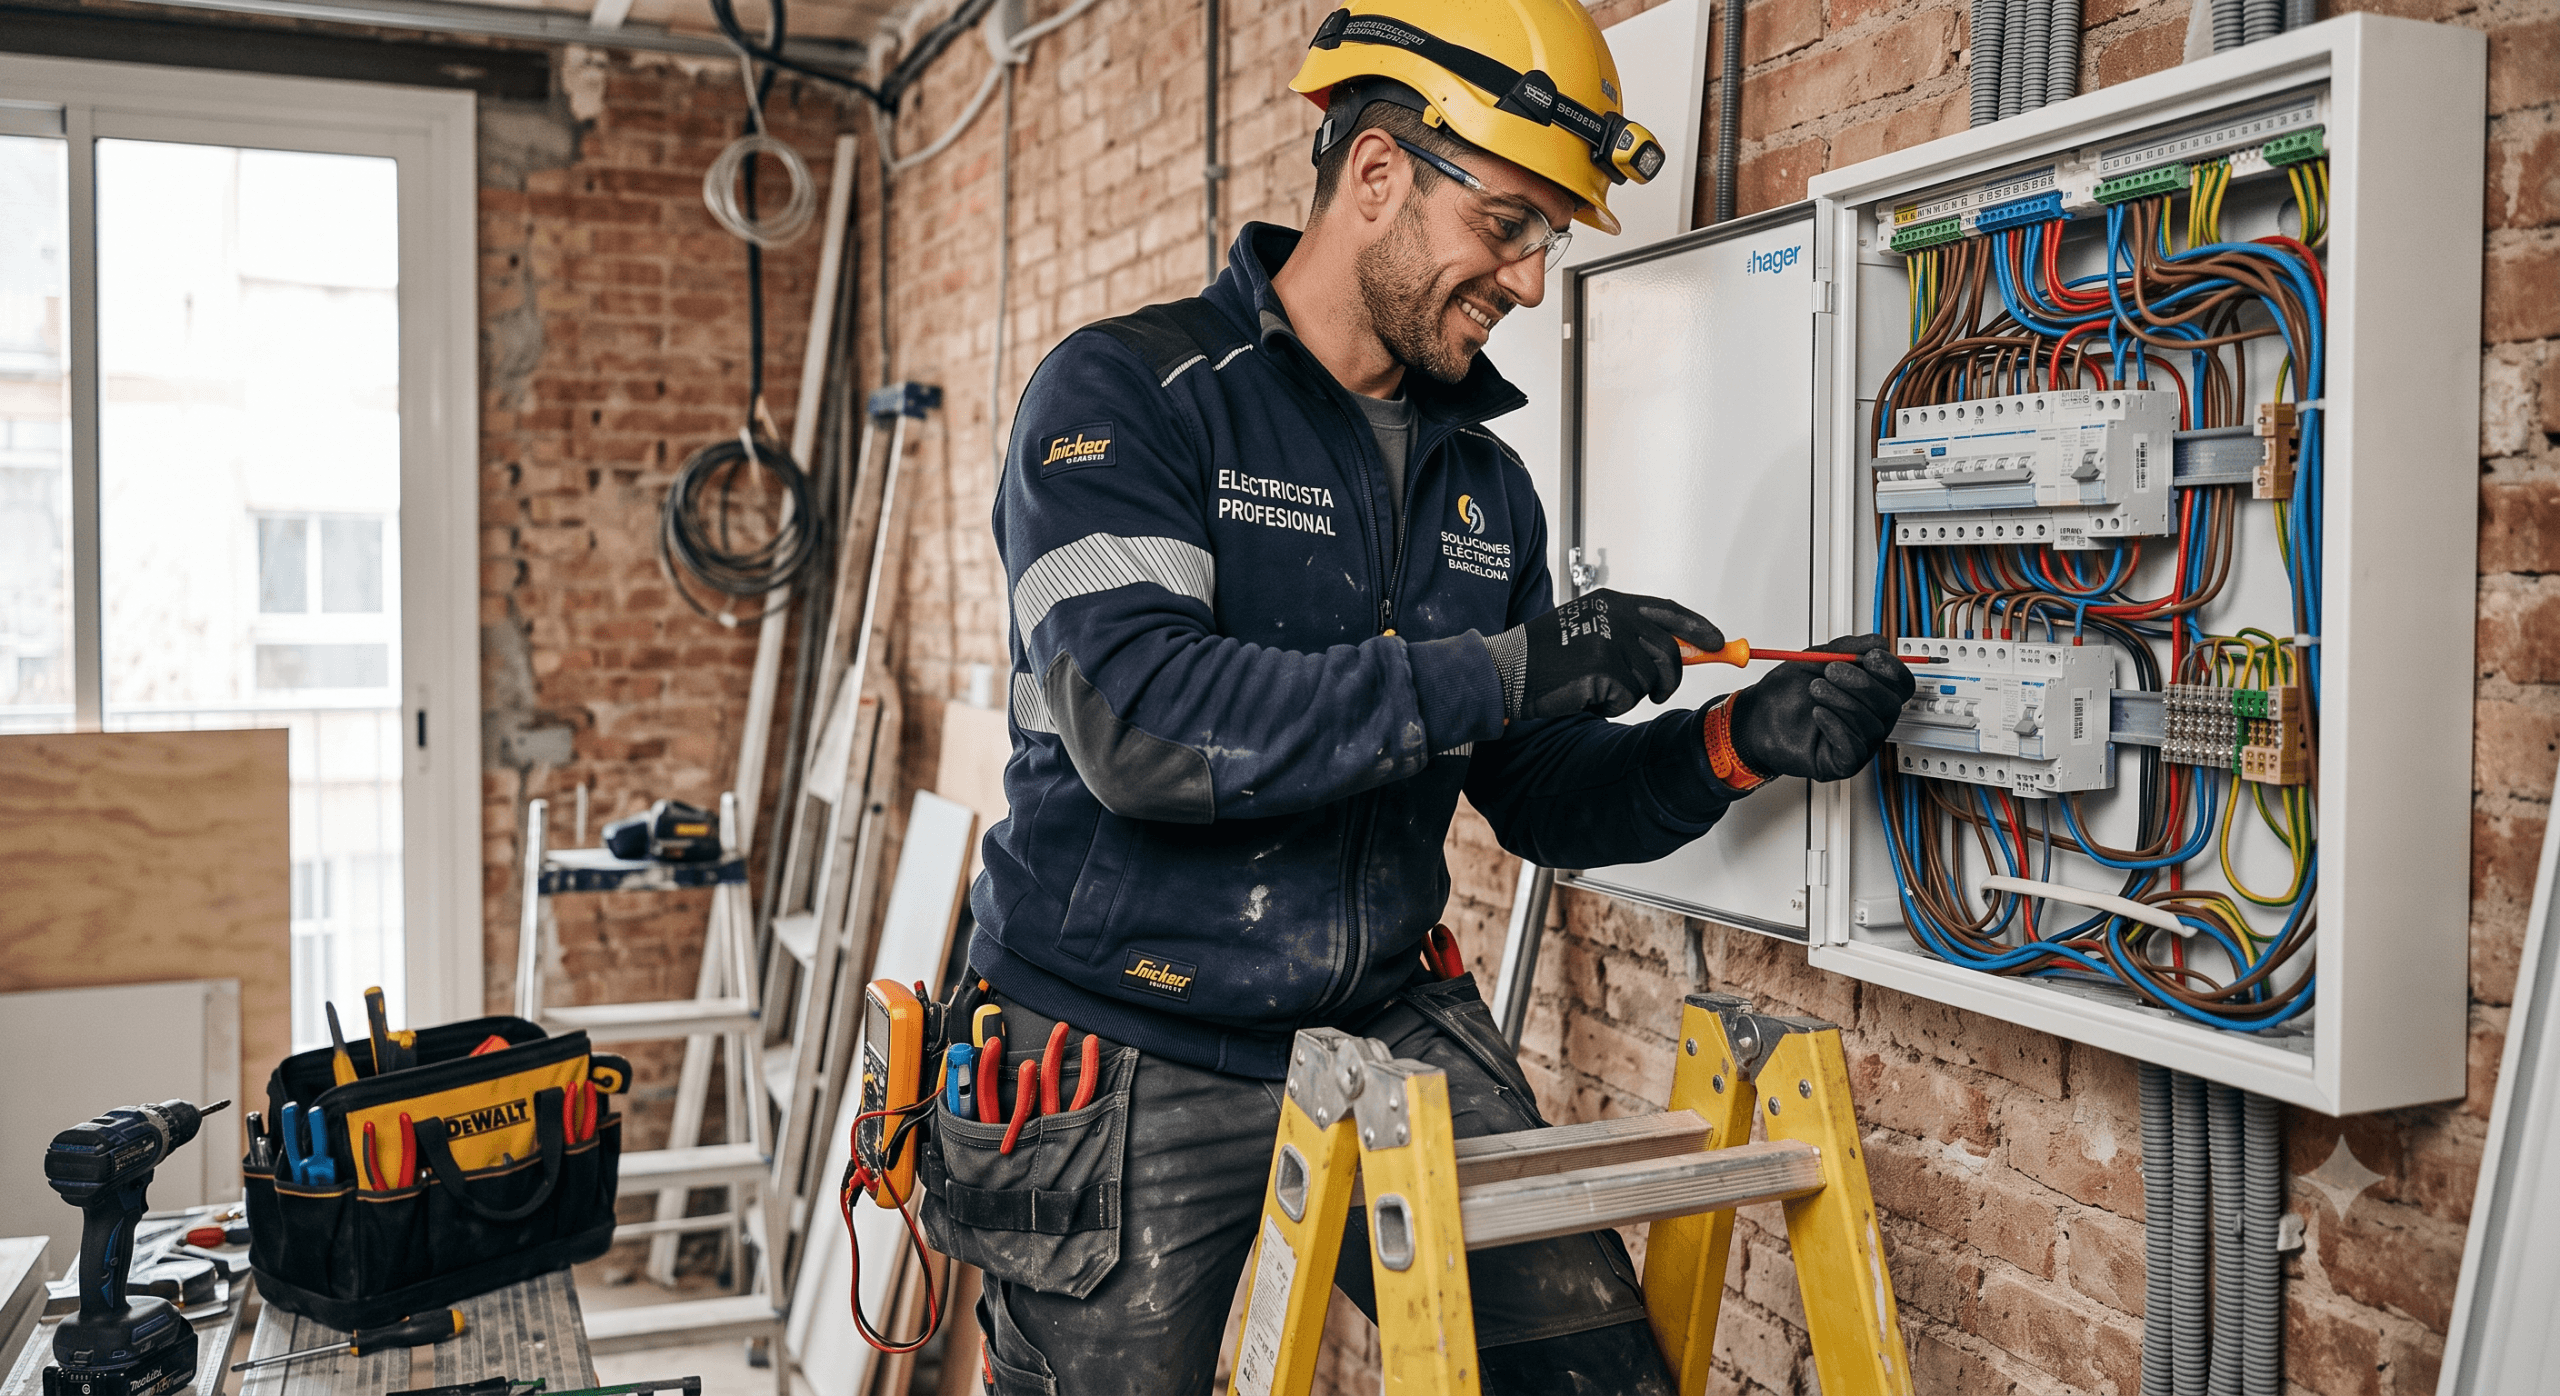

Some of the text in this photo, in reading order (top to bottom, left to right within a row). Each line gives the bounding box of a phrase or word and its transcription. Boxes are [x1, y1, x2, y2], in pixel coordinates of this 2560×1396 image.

[1752, 245, 1801, 274] hager
[1218, 469, 1335, 508] ELECTRICISTA
[1218, 498, 1336, 536] PROFESIONAL
[1441, 531, 1511, 555] SOLUCIONES
[1442, 544, 1511, 568] ELÉCTRICAS
[1448, 558, 1509, 581] BARCELONA
[1125, 959, 1191, 988] Snickers
